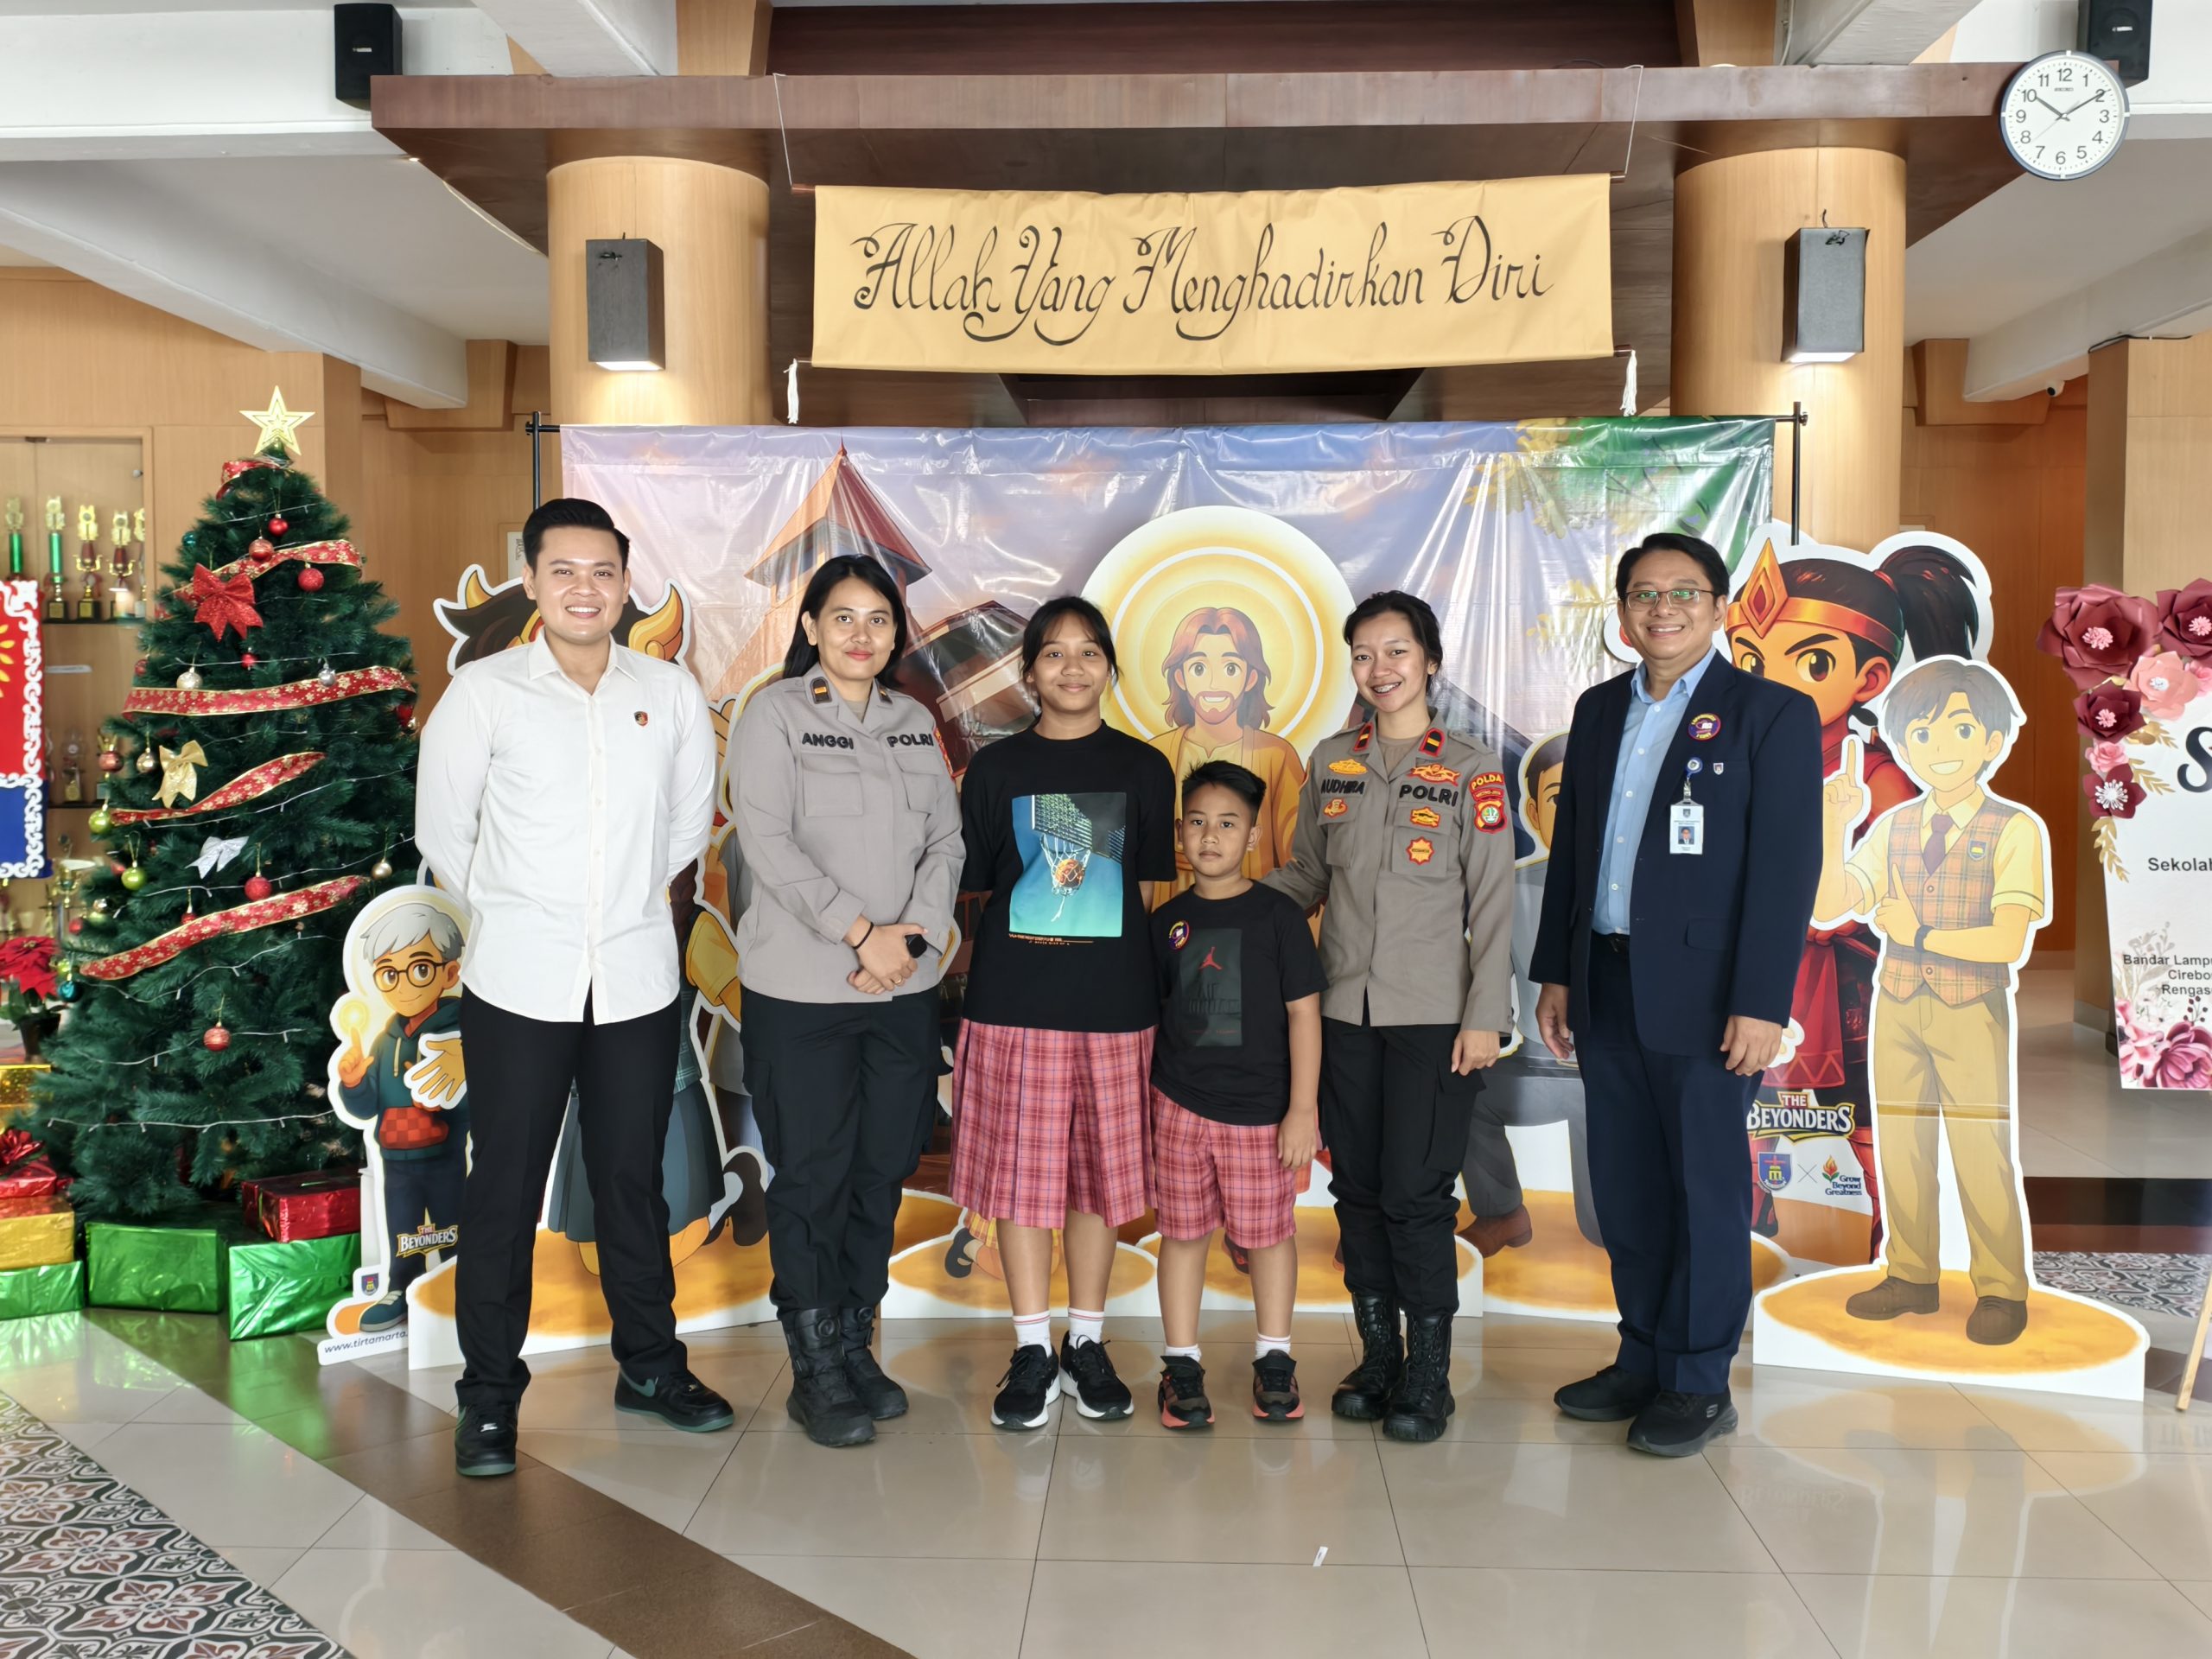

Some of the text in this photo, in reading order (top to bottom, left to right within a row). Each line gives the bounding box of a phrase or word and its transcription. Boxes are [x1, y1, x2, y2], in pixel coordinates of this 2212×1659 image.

[2037, 73, 2050, 87] 11
[2057, 67, 2073, 82] 12
[2082, 73, 2089, 87] 1
[2021, 89, 2037, 103] 10
[2094, 88, 2106, 103] 2
[2016, 109, 2026, 123] 9
[2099, 109, 2109, 123] 3
[2020, 130, 2031, 144] 8
[2092, 130, 2103, 144] 4
[2035, 145, 2045, 159] 7
[2056, 151, 2066, 165] 6
[2076, 145, 2087, 159] 5
[850, 214, 1555, 346] Allah Yang Menghadirkan Diri
[802, 732, 855, 750] ANGGI
[887, 733, 935, 748] POLRI
[1471, 773, 1503, 791] POLDA
[1398, 784, 1459, 807] POLRI
[2122, 954, 2212, 969] Bandar Lamp
[2168, 969, 2212, 981] Cirebo
[2162, 983, 2212, 998] Rengas
[1782, 1094, 1807, 1107] THE
[1746, 1103, 1853, 1134] BEYONDERS
[1832, 1180, 1861, 1191] Beyond
[1839, 1174, 1861, 1183] Grow
[1825, 1187, 1863, 1196] Greatness
[400, 1229, 457, 1252] BEYONDERS
